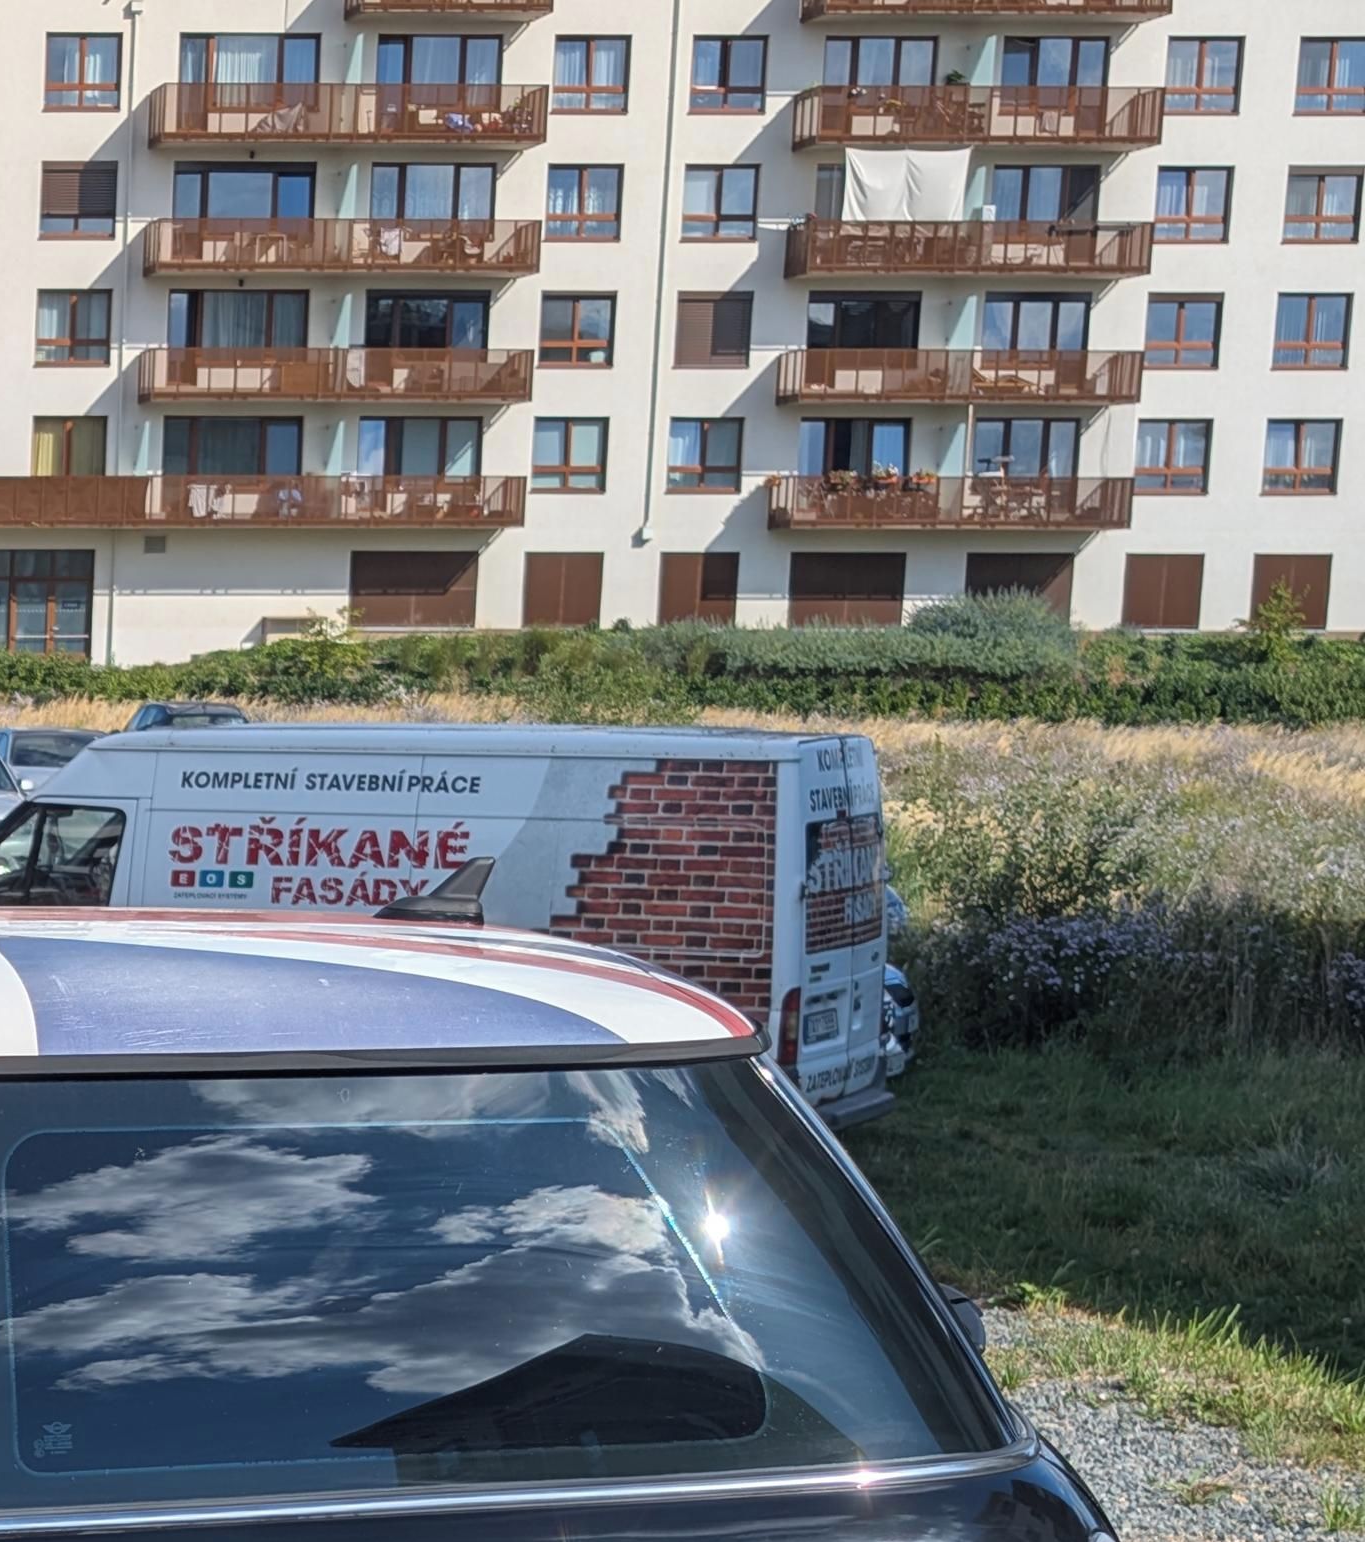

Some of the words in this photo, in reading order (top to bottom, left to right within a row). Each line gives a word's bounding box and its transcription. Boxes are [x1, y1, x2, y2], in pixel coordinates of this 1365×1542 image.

[180, 768, 298, 790] KOMPLETNÍ
[305, 769, 406, 793] STAVEBNÍ
[407, 770, 481, 793] PRÁCE
[169, 816, 470, 869] STŘÍKANÉ
[270, 871, 431, 906] FASÁDY
